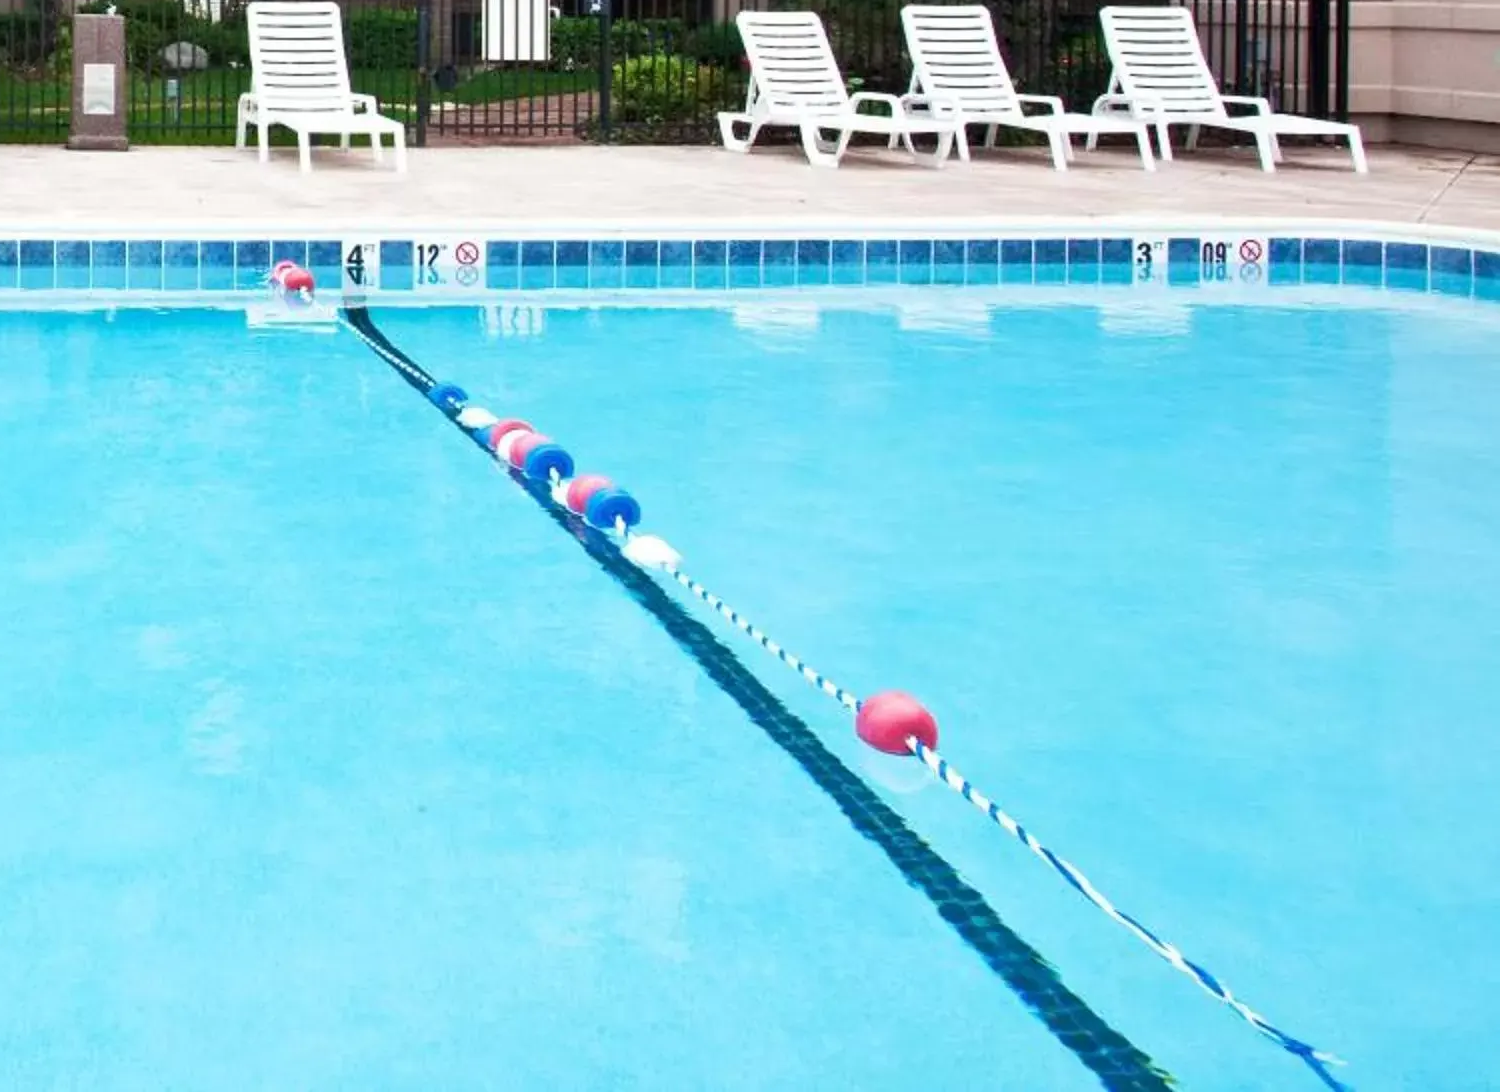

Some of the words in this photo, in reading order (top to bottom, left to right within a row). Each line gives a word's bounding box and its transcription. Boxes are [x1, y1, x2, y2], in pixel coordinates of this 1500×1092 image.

[346, 243, 365, 265] 4
[417, 243, 440, 267] 12
[1136, 241, 1152, 264] 3
[1202, 241, 1227, 264] 09
